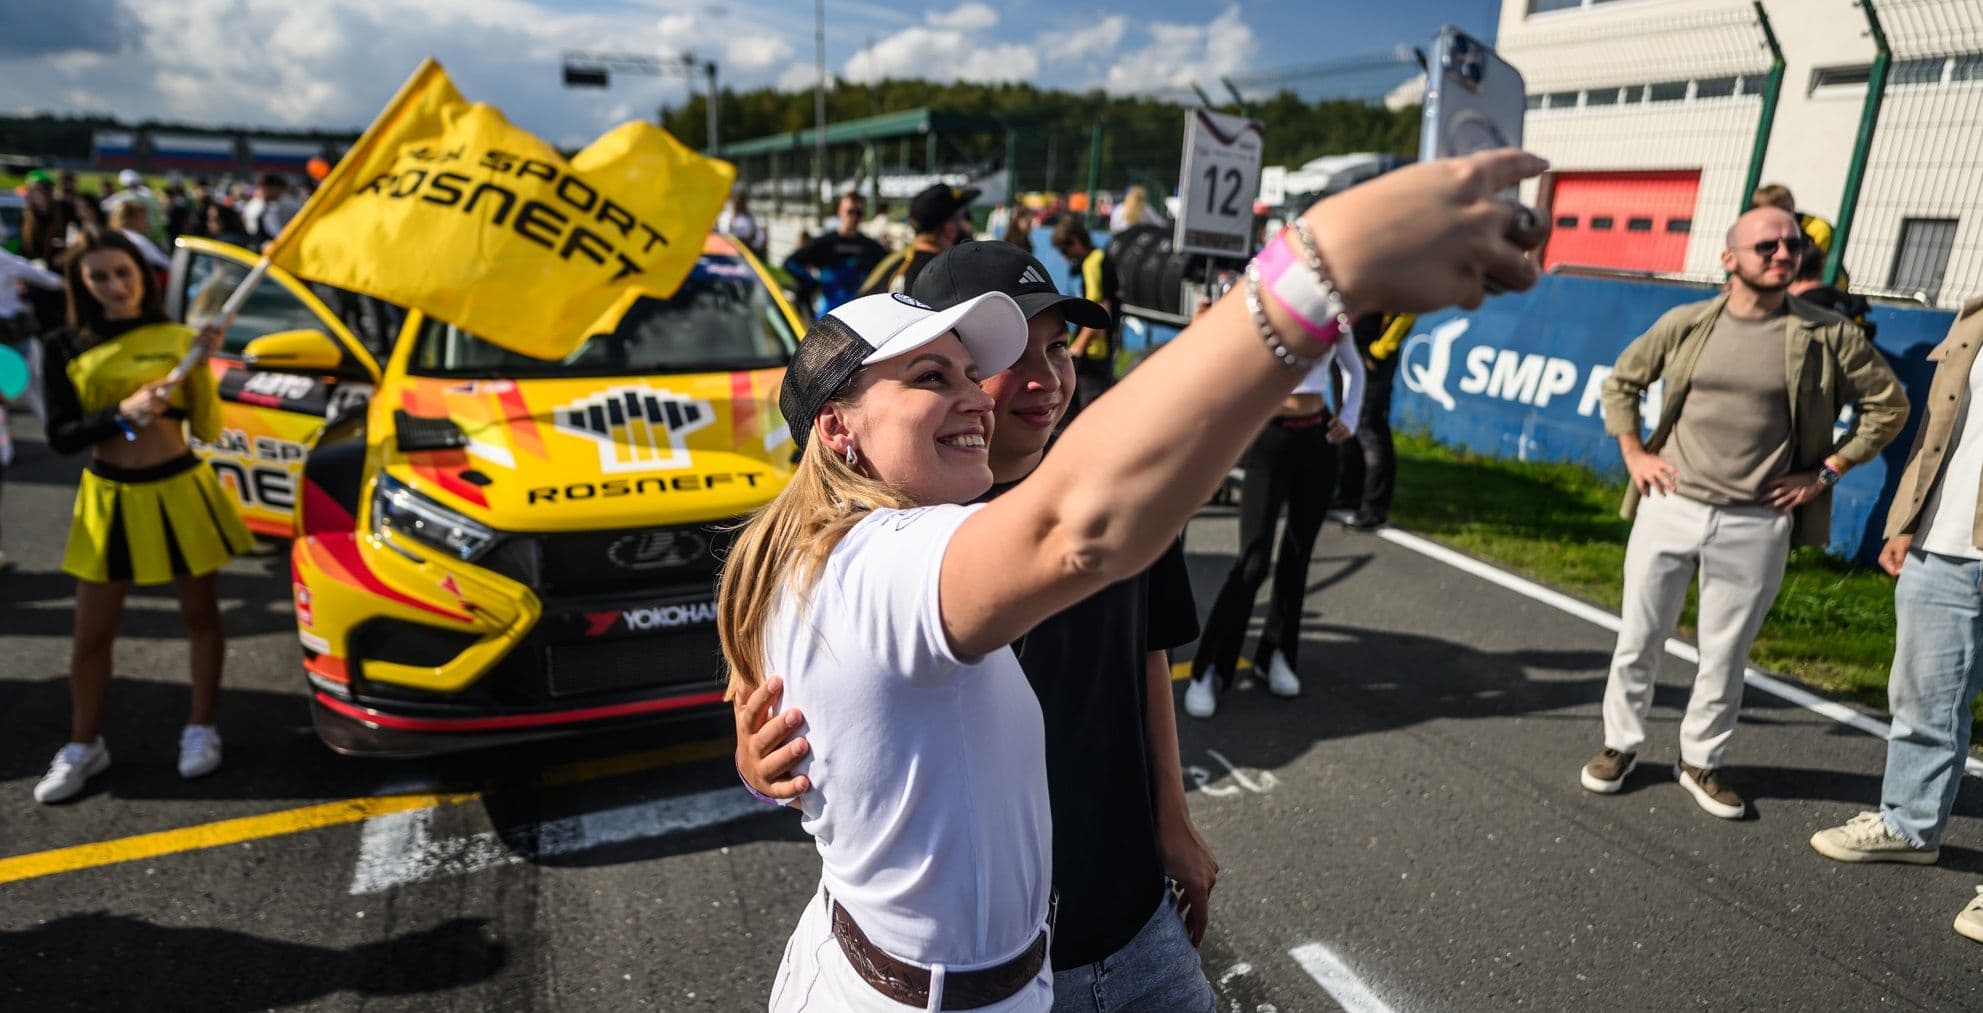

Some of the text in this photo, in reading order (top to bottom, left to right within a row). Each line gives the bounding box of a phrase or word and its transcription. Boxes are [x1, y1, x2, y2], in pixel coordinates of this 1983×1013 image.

[480, 151, 668, 254] SPORT
[1203, 163, 1244, 217] 12
[356, 168, 645, 284] ROSNEFT
[1459, 345, 1578, 408] SMP
[527, 471, 764, 506] ROSNEFT
[622, 601, 718, 632] YOKOHA
